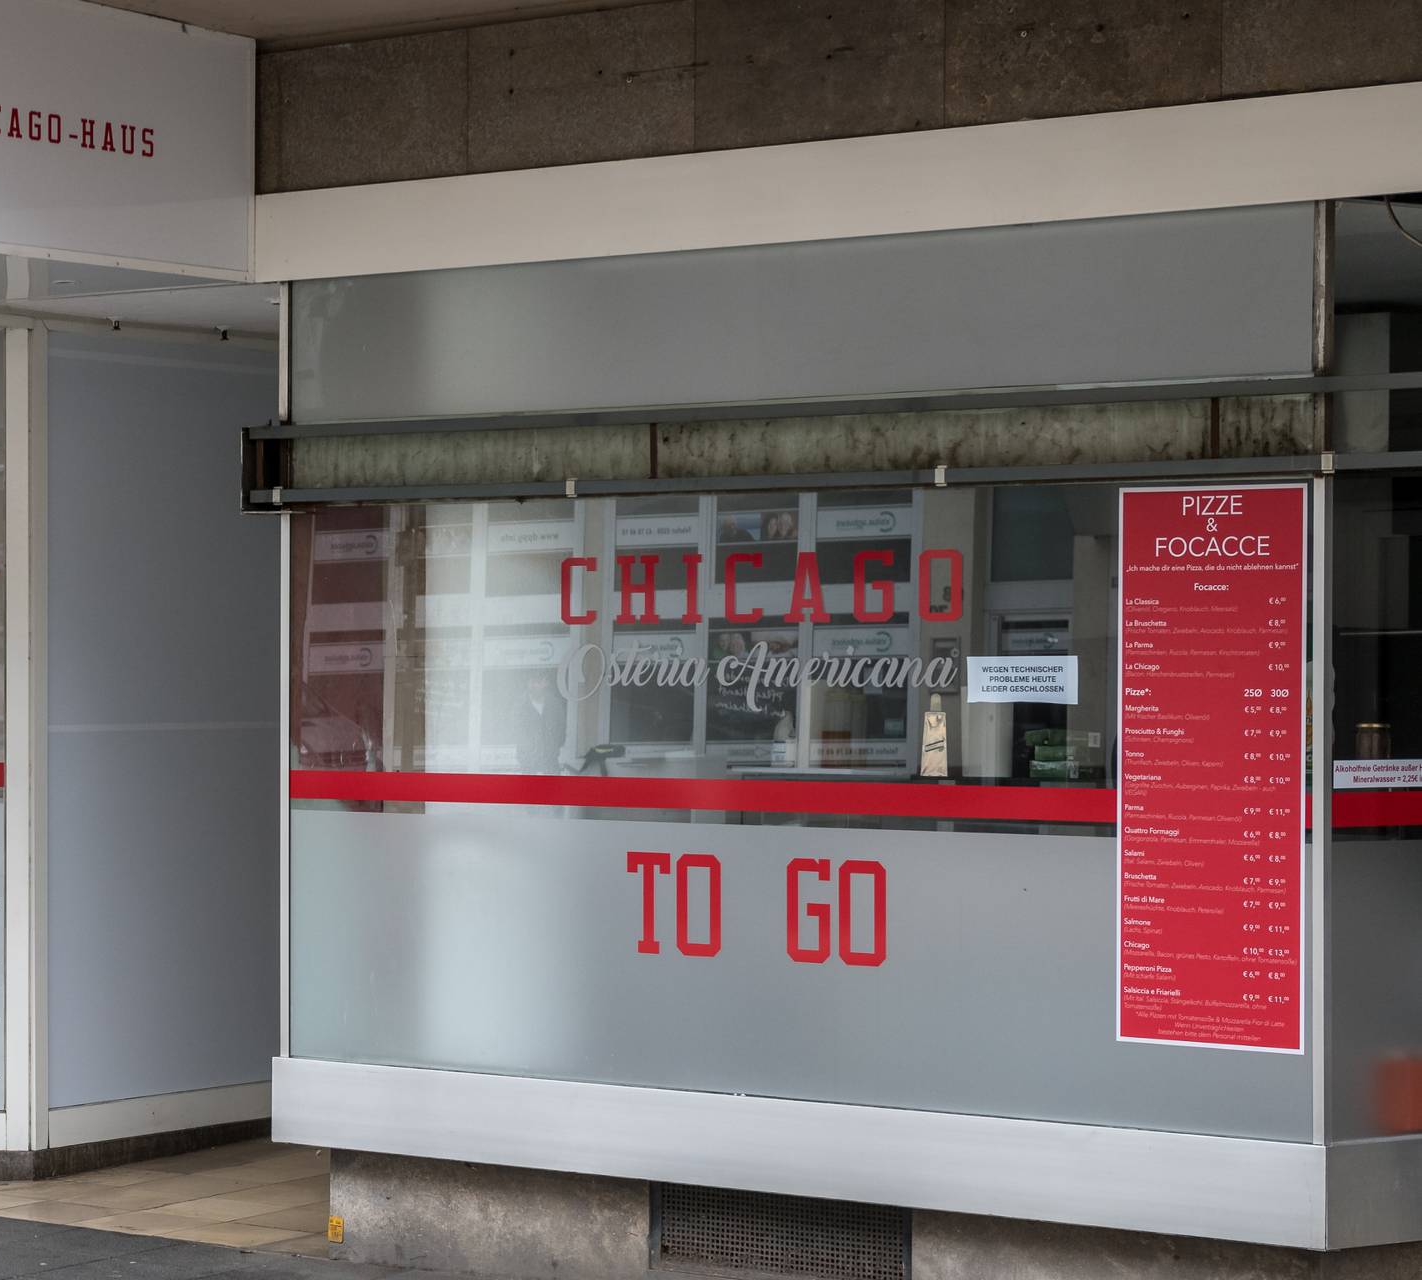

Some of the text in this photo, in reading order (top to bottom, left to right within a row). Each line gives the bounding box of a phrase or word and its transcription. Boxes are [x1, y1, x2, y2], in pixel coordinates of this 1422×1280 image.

[1182, 495, 1243, 516] PIZZE
[1206, 518, 1218, 532] &
[1155, 536, 1271, 558] FOCACCE
[560, 548, 964, 626] CHICAGO
[1194, 583, 1229, 591] Focacce:
[557, 641, 710, 703] Osteria
[715, 641, 958, 712] Americana
[1335, 764, 1372, 772] Alkoholfreie
[1372, 764, 1400, 772] Getränke
[1400, 764, 1418, 772] außer
[1352, 776, 1396, 784] Mineralwasser
[1402, 775, 1418, 783] 2,25€
[627, 851, 887, 967] TO GO
[1124, 941, 1149, 949] Chicago
[1124, 964, 1155, 972] Pepperoni
[1124, 987, 1149, 995] Salsiccia
